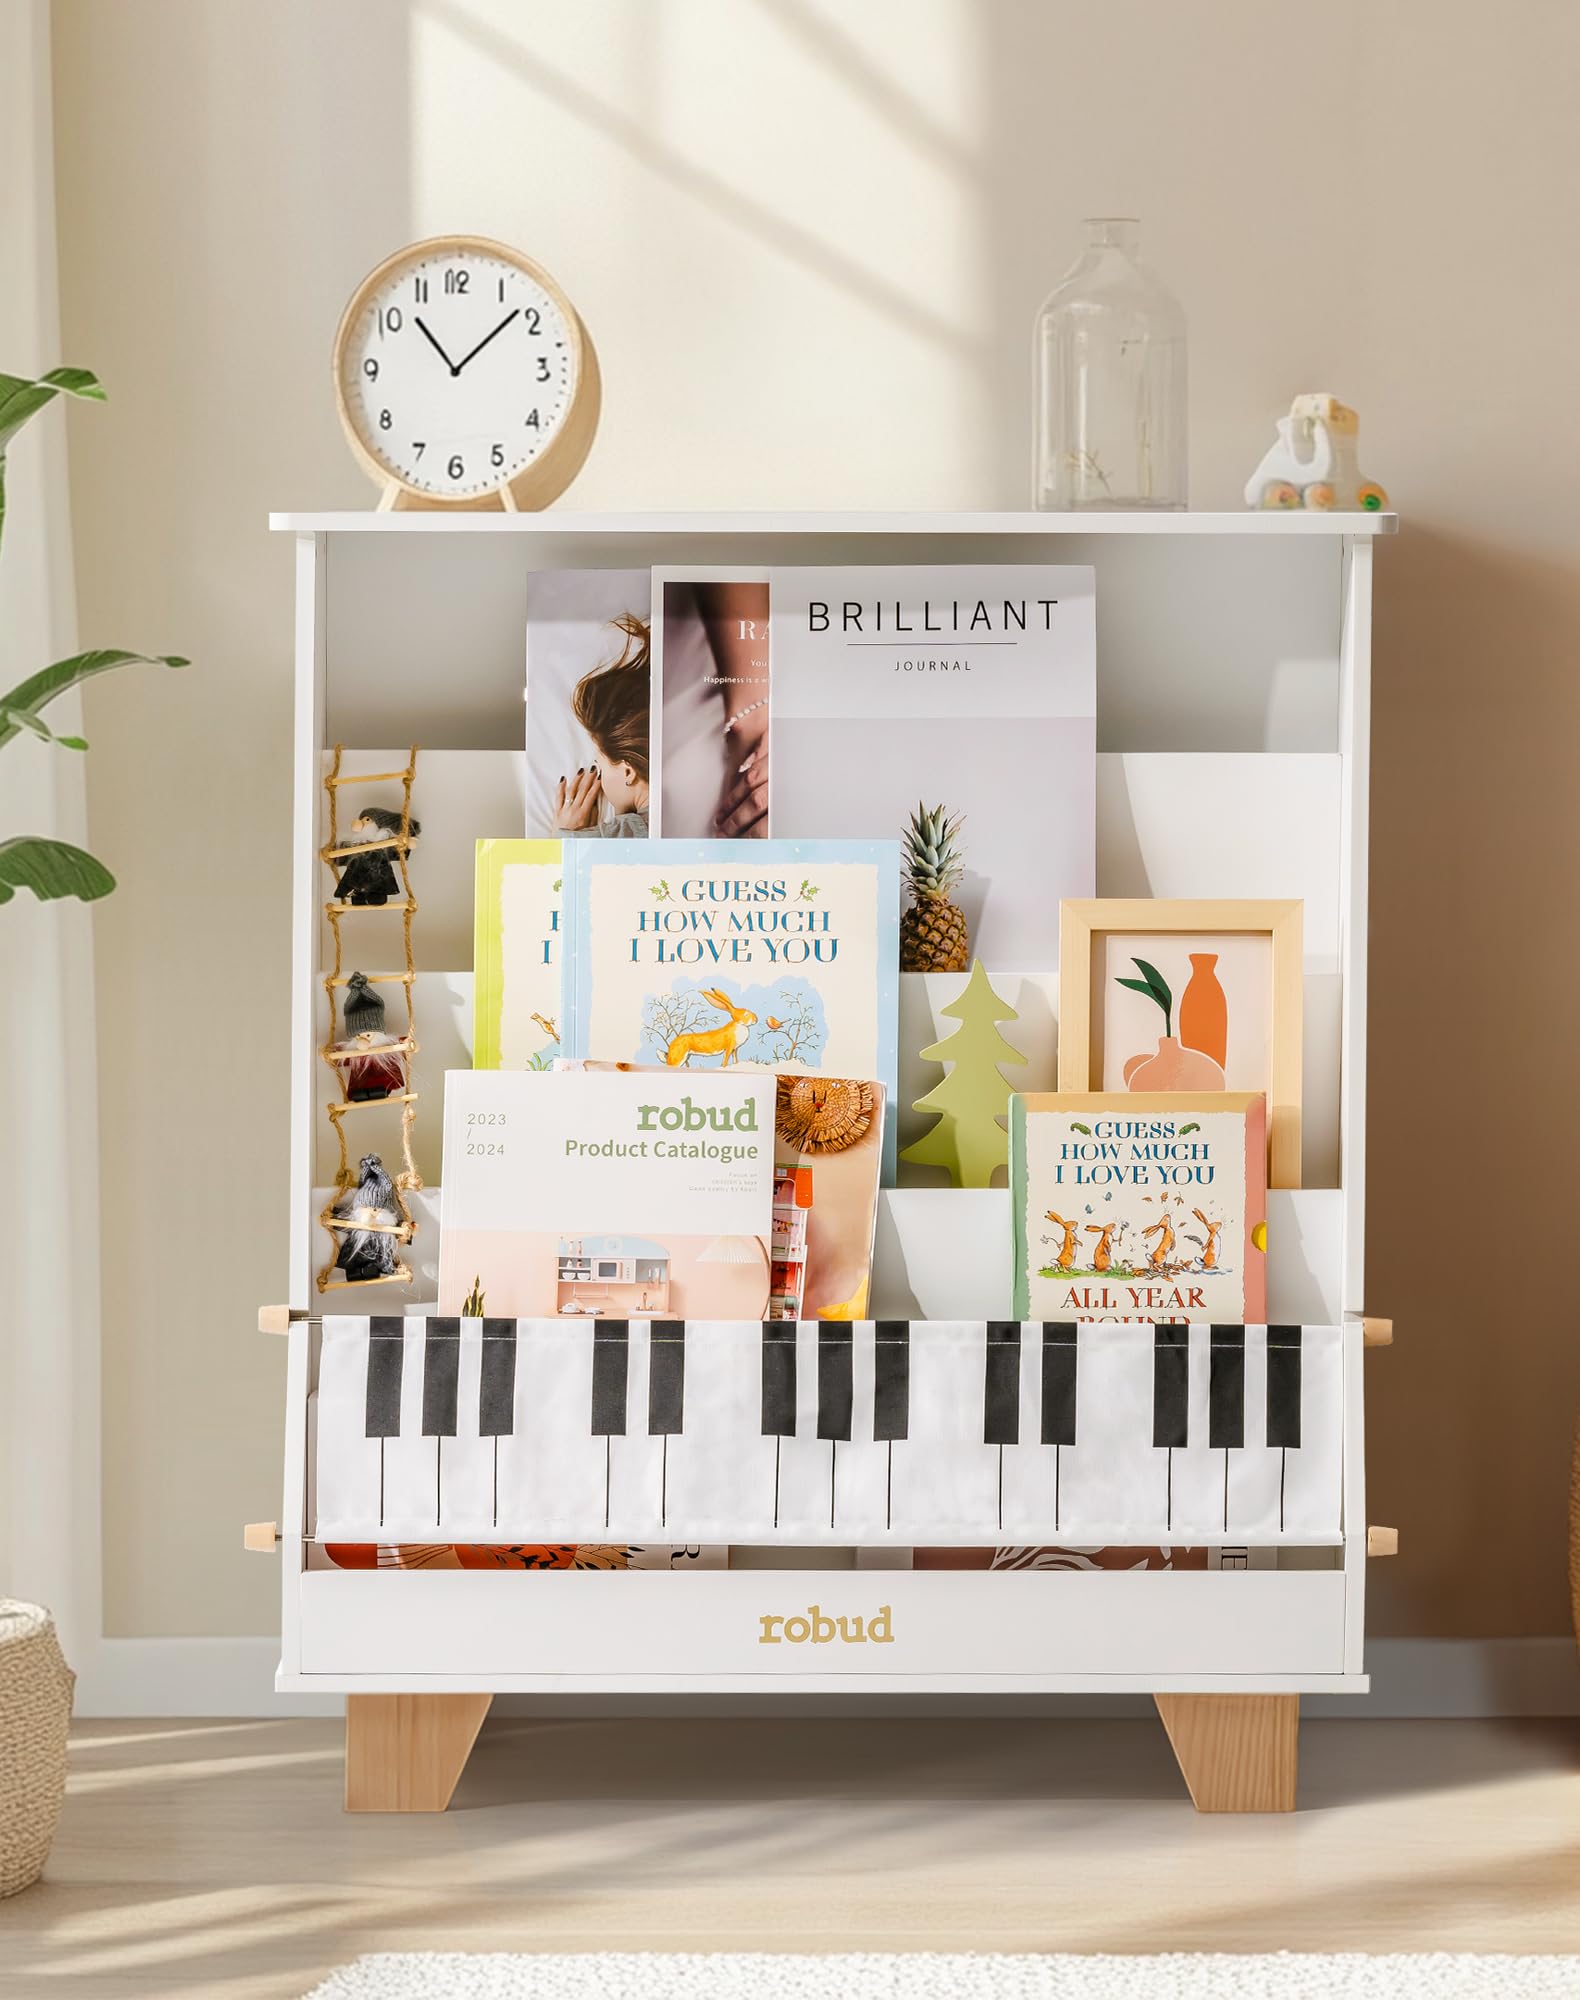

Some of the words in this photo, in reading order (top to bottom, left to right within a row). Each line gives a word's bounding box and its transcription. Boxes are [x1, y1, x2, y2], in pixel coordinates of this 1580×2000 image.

[415, 277, 428, 304] 11
[499, 277, 504, 303] 1
[378, 307, 402, 339] 10
[525, 307, 542, 336] 2
[363, 358, 379, 382] 9
[536, 357, 551, 383] 3
[379, 408, 393, 430] 8
[525, 408, 540, 431] 4
[412, 442, 426, 461] 7
[491, 443, 504, 467] 5
[448, 455, 464, 480] 6
[809, 600, 1058, 632] BRILLIANT
[895, 660, 972, 672] JOURNAL
[703, 676, 744, 685] Happiness
[681, 879, 787, 902] GUESS
[637, 910, 717, 933] HOW
[728, 910, 831, 933] MUCH
[629, 938, 641, 964] I
[653, 938, 752, 965] LOVE
[761, 938, 840, 965] YOU
[467, 1113, 506, 1125] 2023
[637, 1096, 759, 1132] robud
[1094, 1121, 1176, 1139] GUESS
[467, 1144, 505, 1155] 2024
[565, 1138, 648, 1158] Product
[653, 1140, 759, 1163] Catalogue
[1060, 1143, 1121, 1161] HOW
[1130, 1143, 1210, 1161] MUCH
[1054, 1165, 1065, 1184] I
[1074, 1165, 1149, 1185] LOVE
[1155, 1165, 1215, 1185] YOU
[1060, 1287, 1118, 1309] ALL
[1125, 1287, 1207, 1309] YEAR
[759, 1605, 895, 1644] robud
